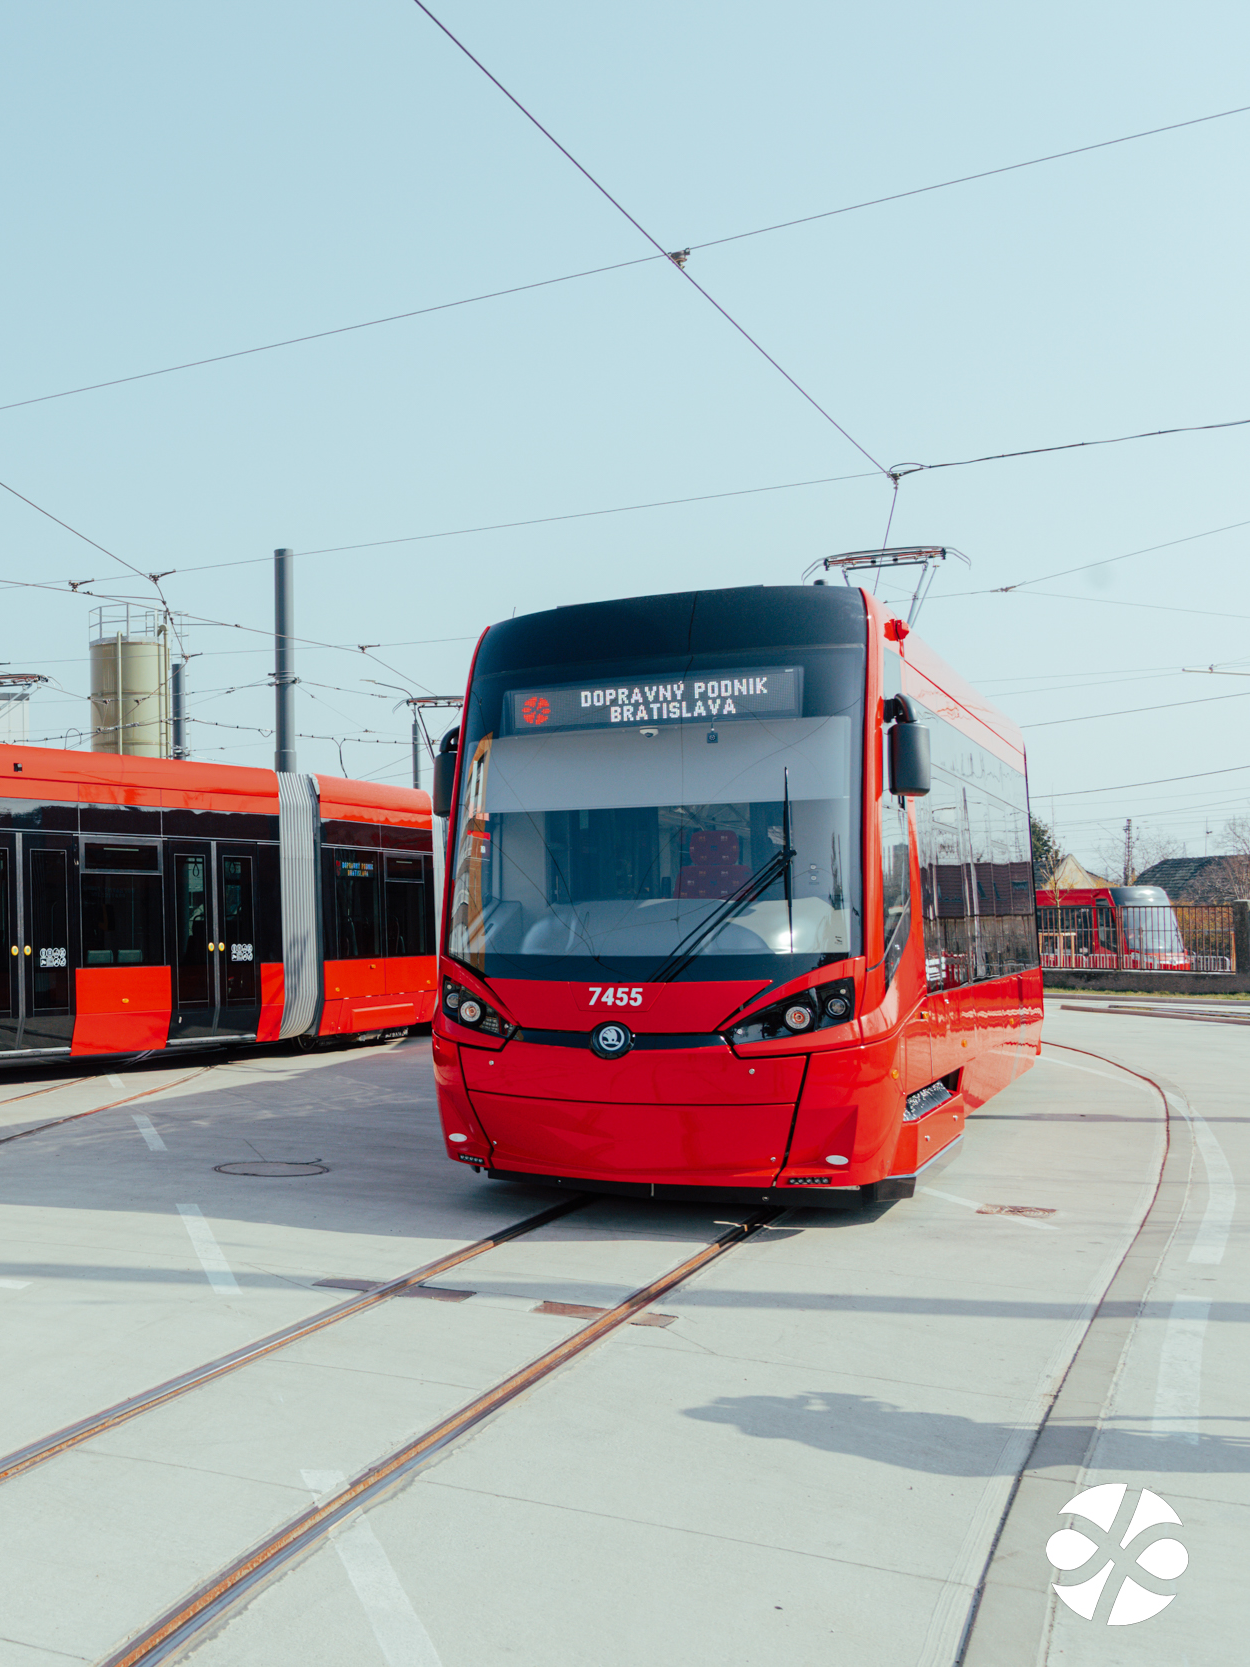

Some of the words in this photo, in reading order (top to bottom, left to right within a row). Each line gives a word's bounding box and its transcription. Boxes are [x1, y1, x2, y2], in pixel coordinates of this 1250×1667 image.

[580, 681, 684, 708] DOPRAVNÝ
[694, 677, 768, 699] PODNIK
[610, 698, 737, 723] BRATISLAVA
[588, 986, 643, 1007] 7455
